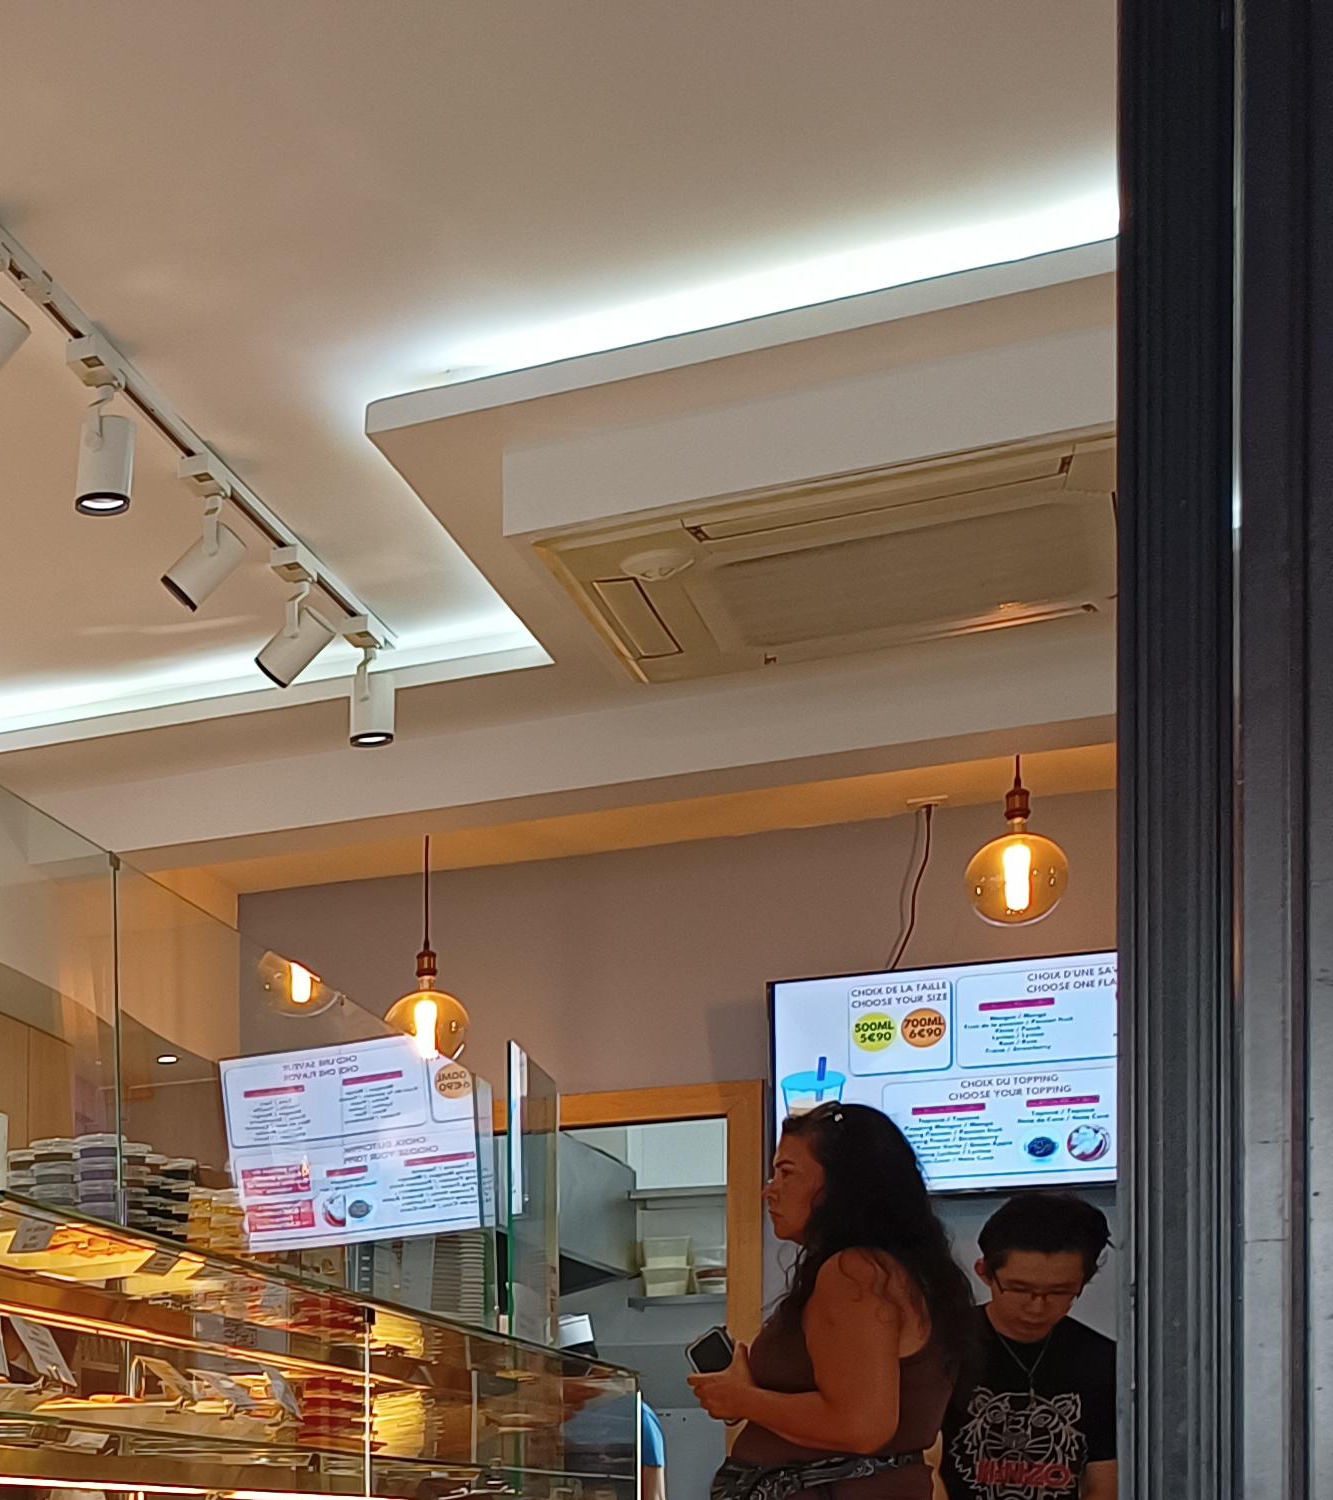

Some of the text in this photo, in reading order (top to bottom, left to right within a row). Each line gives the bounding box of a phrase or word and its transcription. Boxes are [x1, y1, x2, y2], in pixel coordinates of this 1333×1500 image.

[885, 985, 897, 995] DE
[900, 984, 913, 993] LA
[1026, 982, 1071, 993] CHOOSE
[1073, 980, 1096, 989] ONE
[851, 992, 948, 1008] CHOOSE YOUR SIZE
[855, 1020, 895, 1033] 500ML
[903, 1016, 944, 1029] 700ML
[860, 1031, 892, 1043] 5€90
[908, 1027, 942, 1039] 6€90
[949, 1090, 991, 1101] CHOOSE
